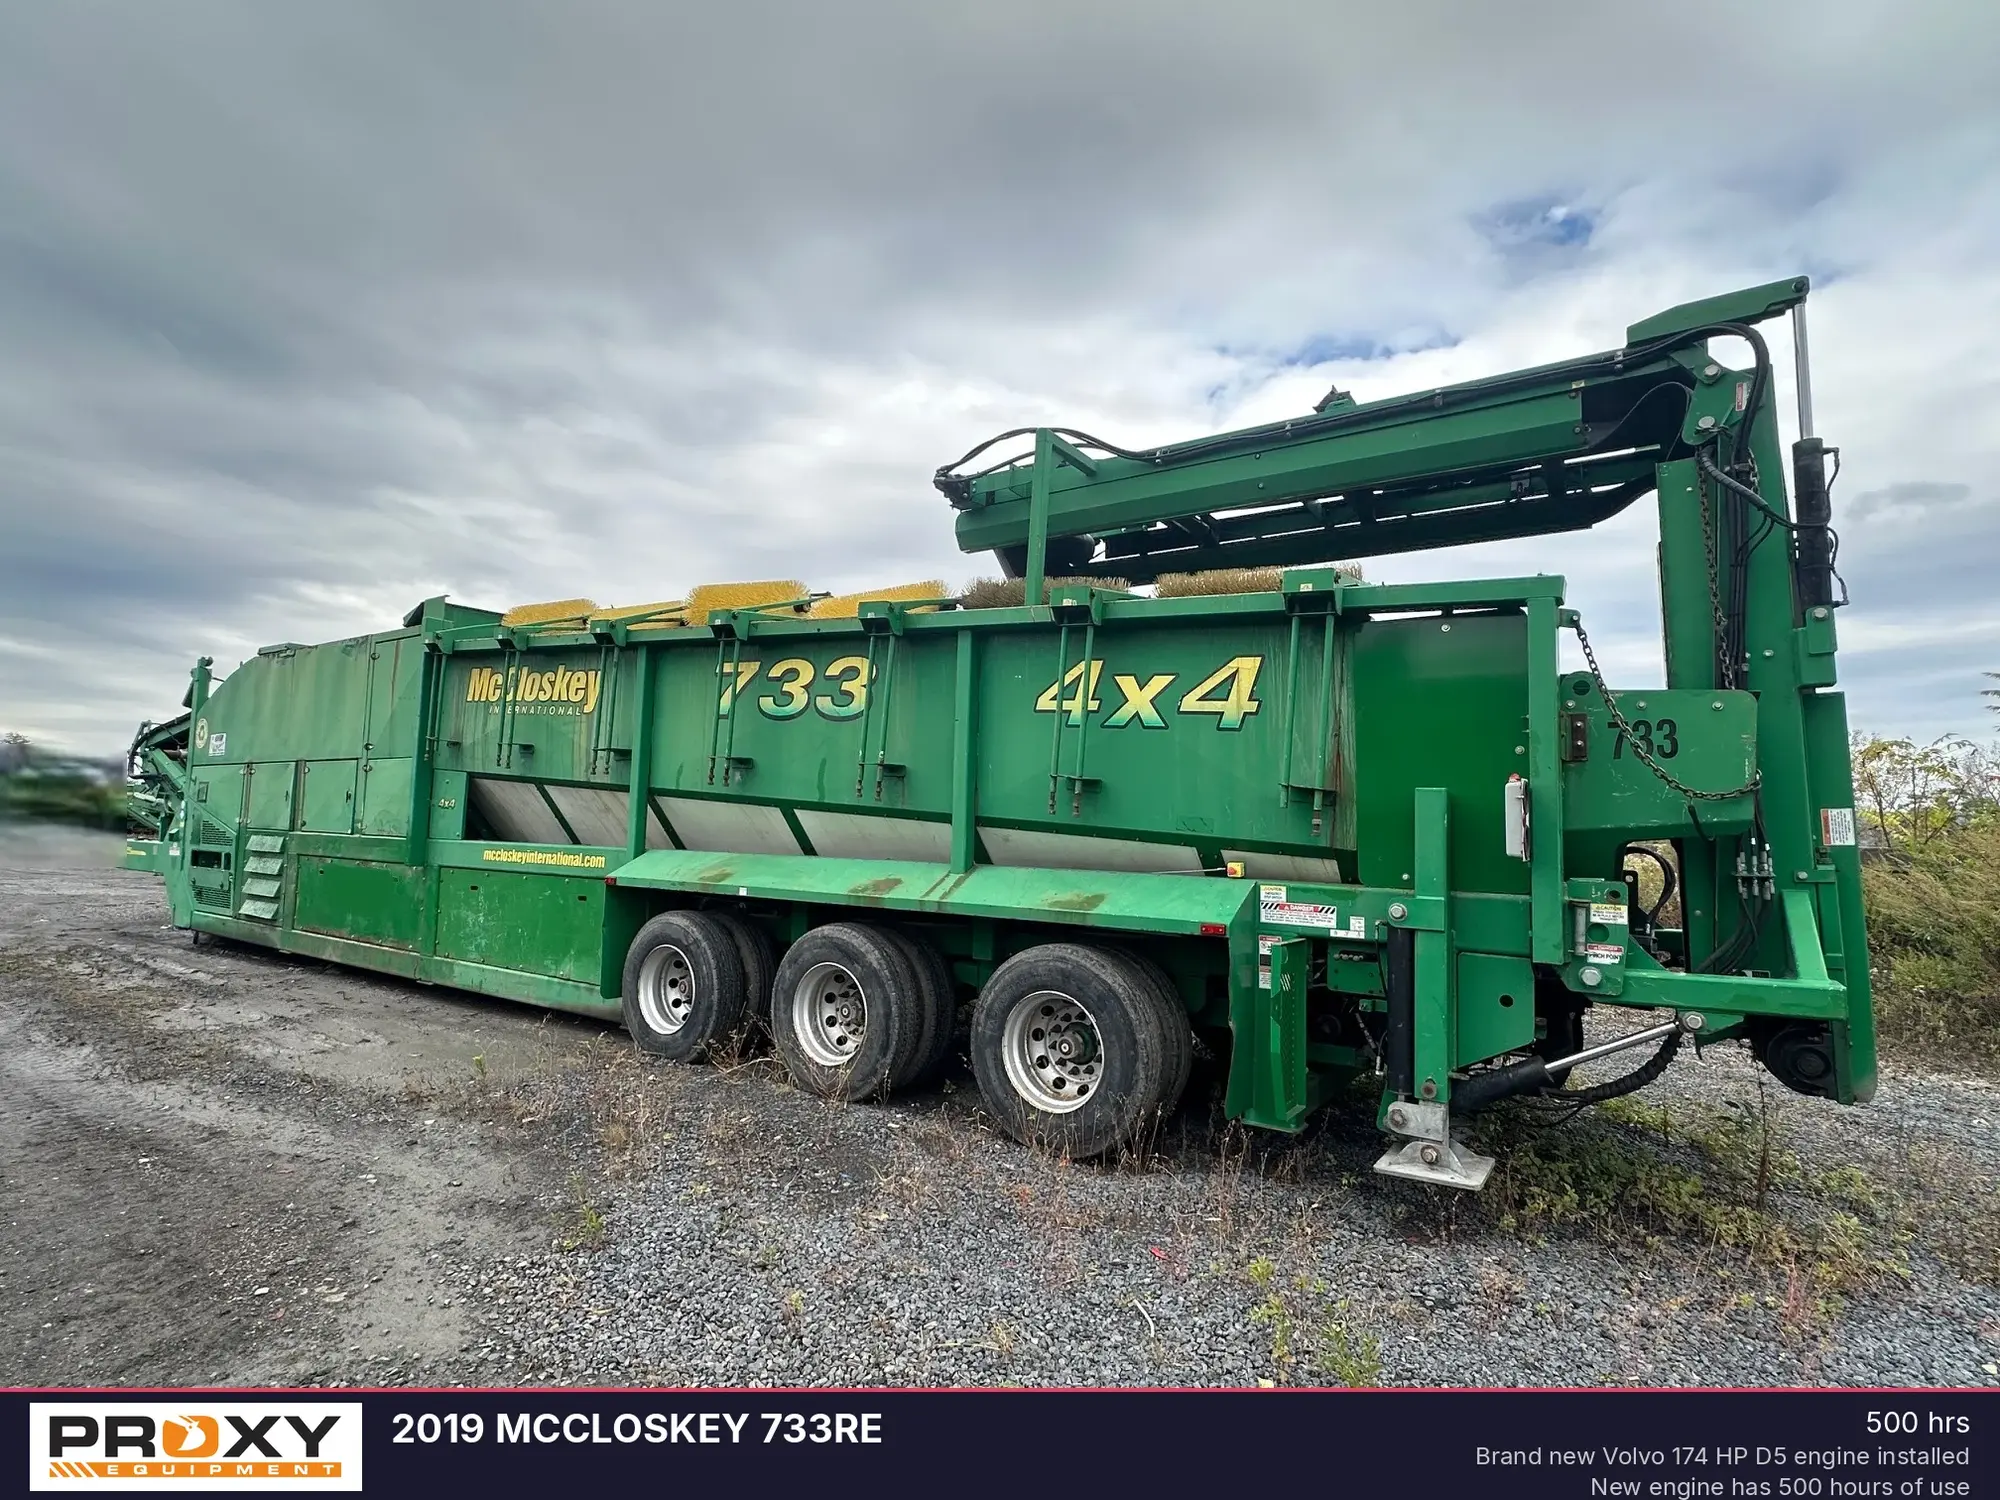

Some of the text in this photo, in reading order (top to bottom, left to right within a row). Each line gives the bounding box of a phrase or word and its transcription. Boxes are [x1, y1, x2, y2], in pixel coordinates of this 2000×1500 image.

[715, 655, 878, 722] 733
[1034, 654, 1265, 732] 4x4
[488, 704, 581, 716] INERNATIONAL
[1607, 718, 1679, 760] 733
[438, 798, 456, 809] 4x4
[483, 848, 605, 869] mccloskeyinternational.com
[1289, 904, 1314, 912] DANGER
